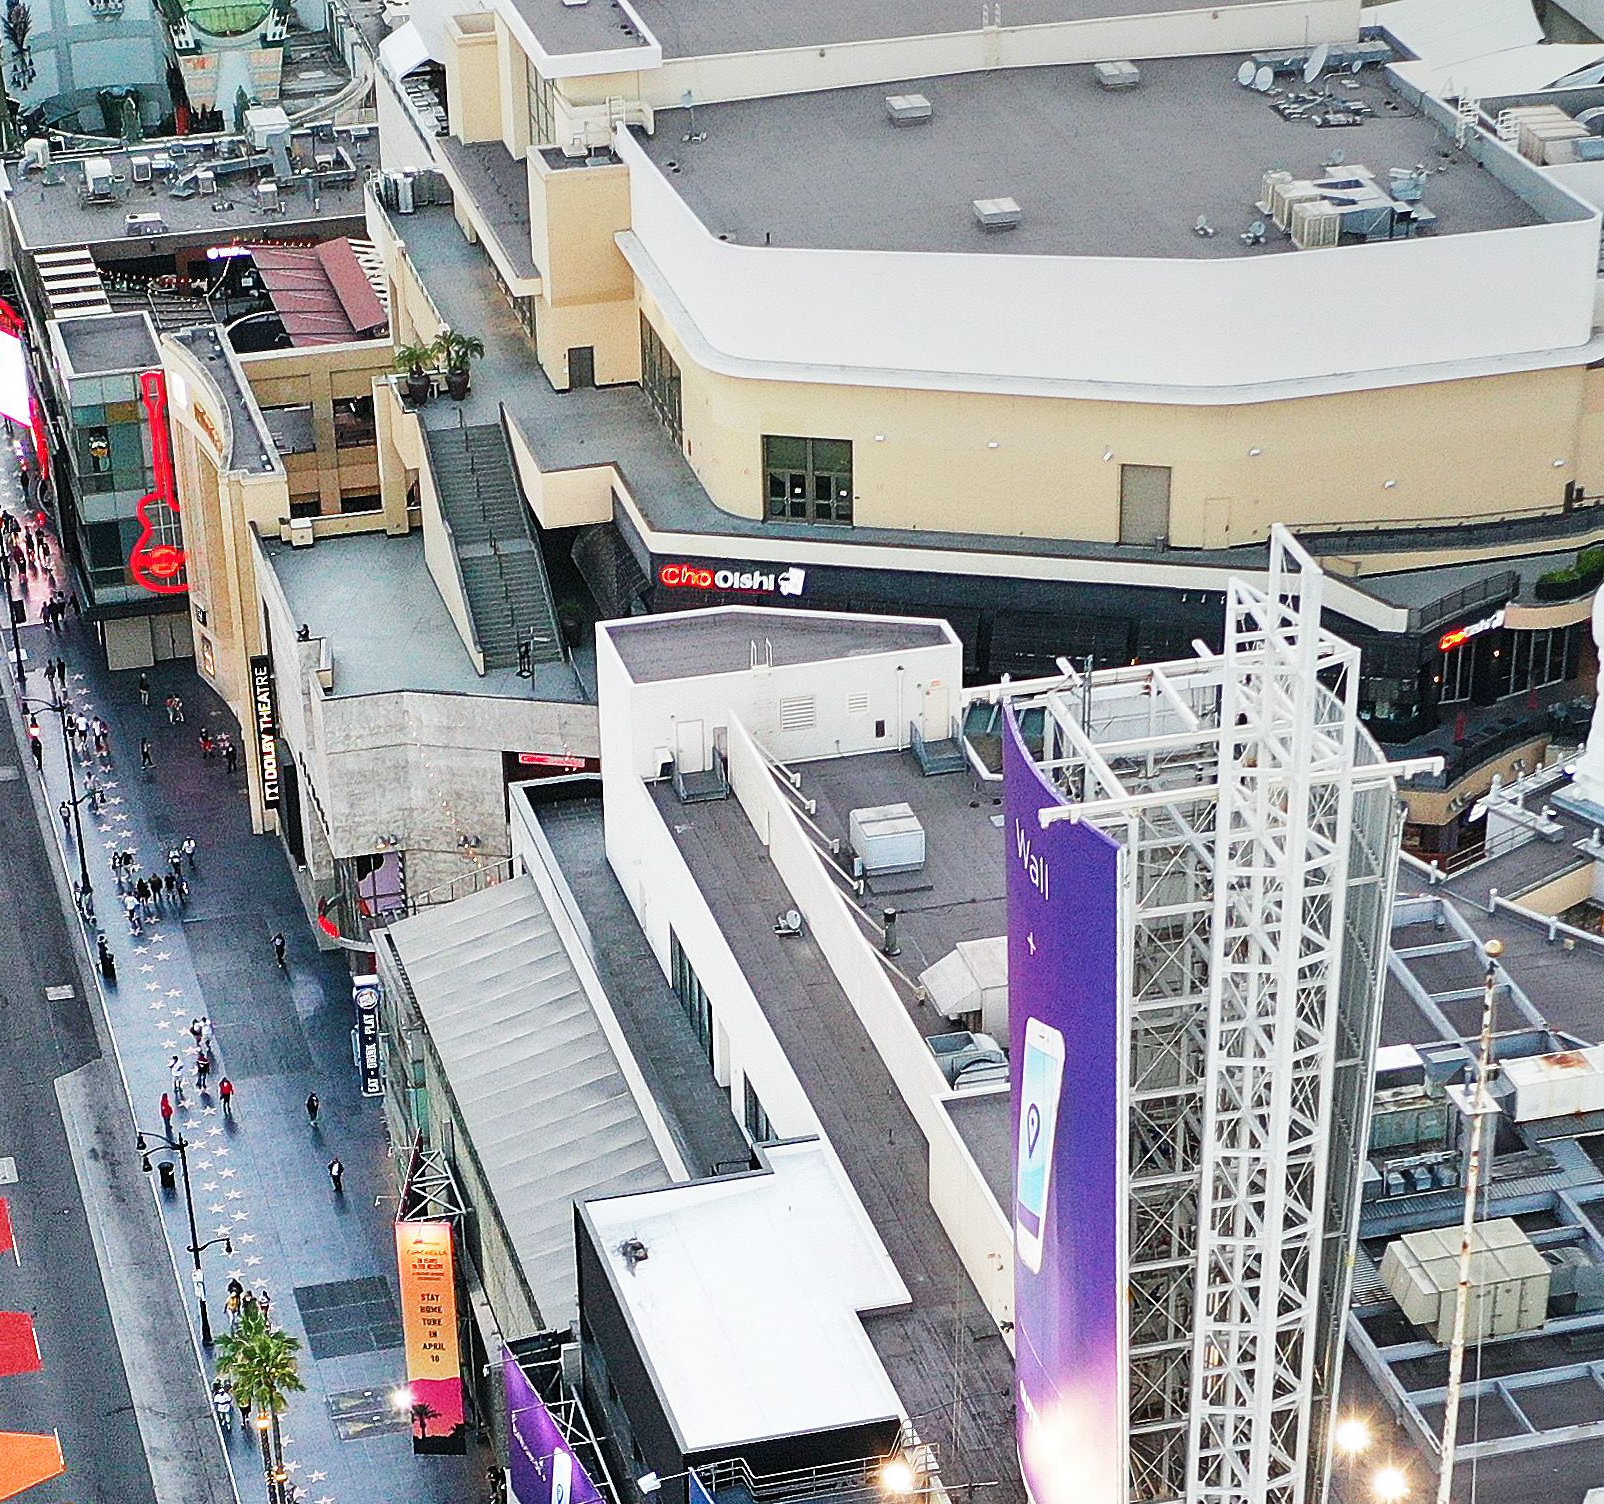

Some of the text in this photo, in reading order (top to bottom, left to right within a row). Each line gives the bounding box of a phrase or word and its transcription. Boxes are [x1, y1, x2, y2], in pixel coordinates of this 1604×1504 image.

[660, 564, 713, 588] Cho
[254, 666, 278, 780] DOLBY THEATRE
[1015, 817, 1049, 901] Wall
[420, 1293, 440, 1302] STAY
[419, 1305, 443, 1314] HOME
[421, 1317, 442, 1326] TUNE
[428, 1329, 438, 1338] IN
[422, 1342, 446, 1351] APRIL
